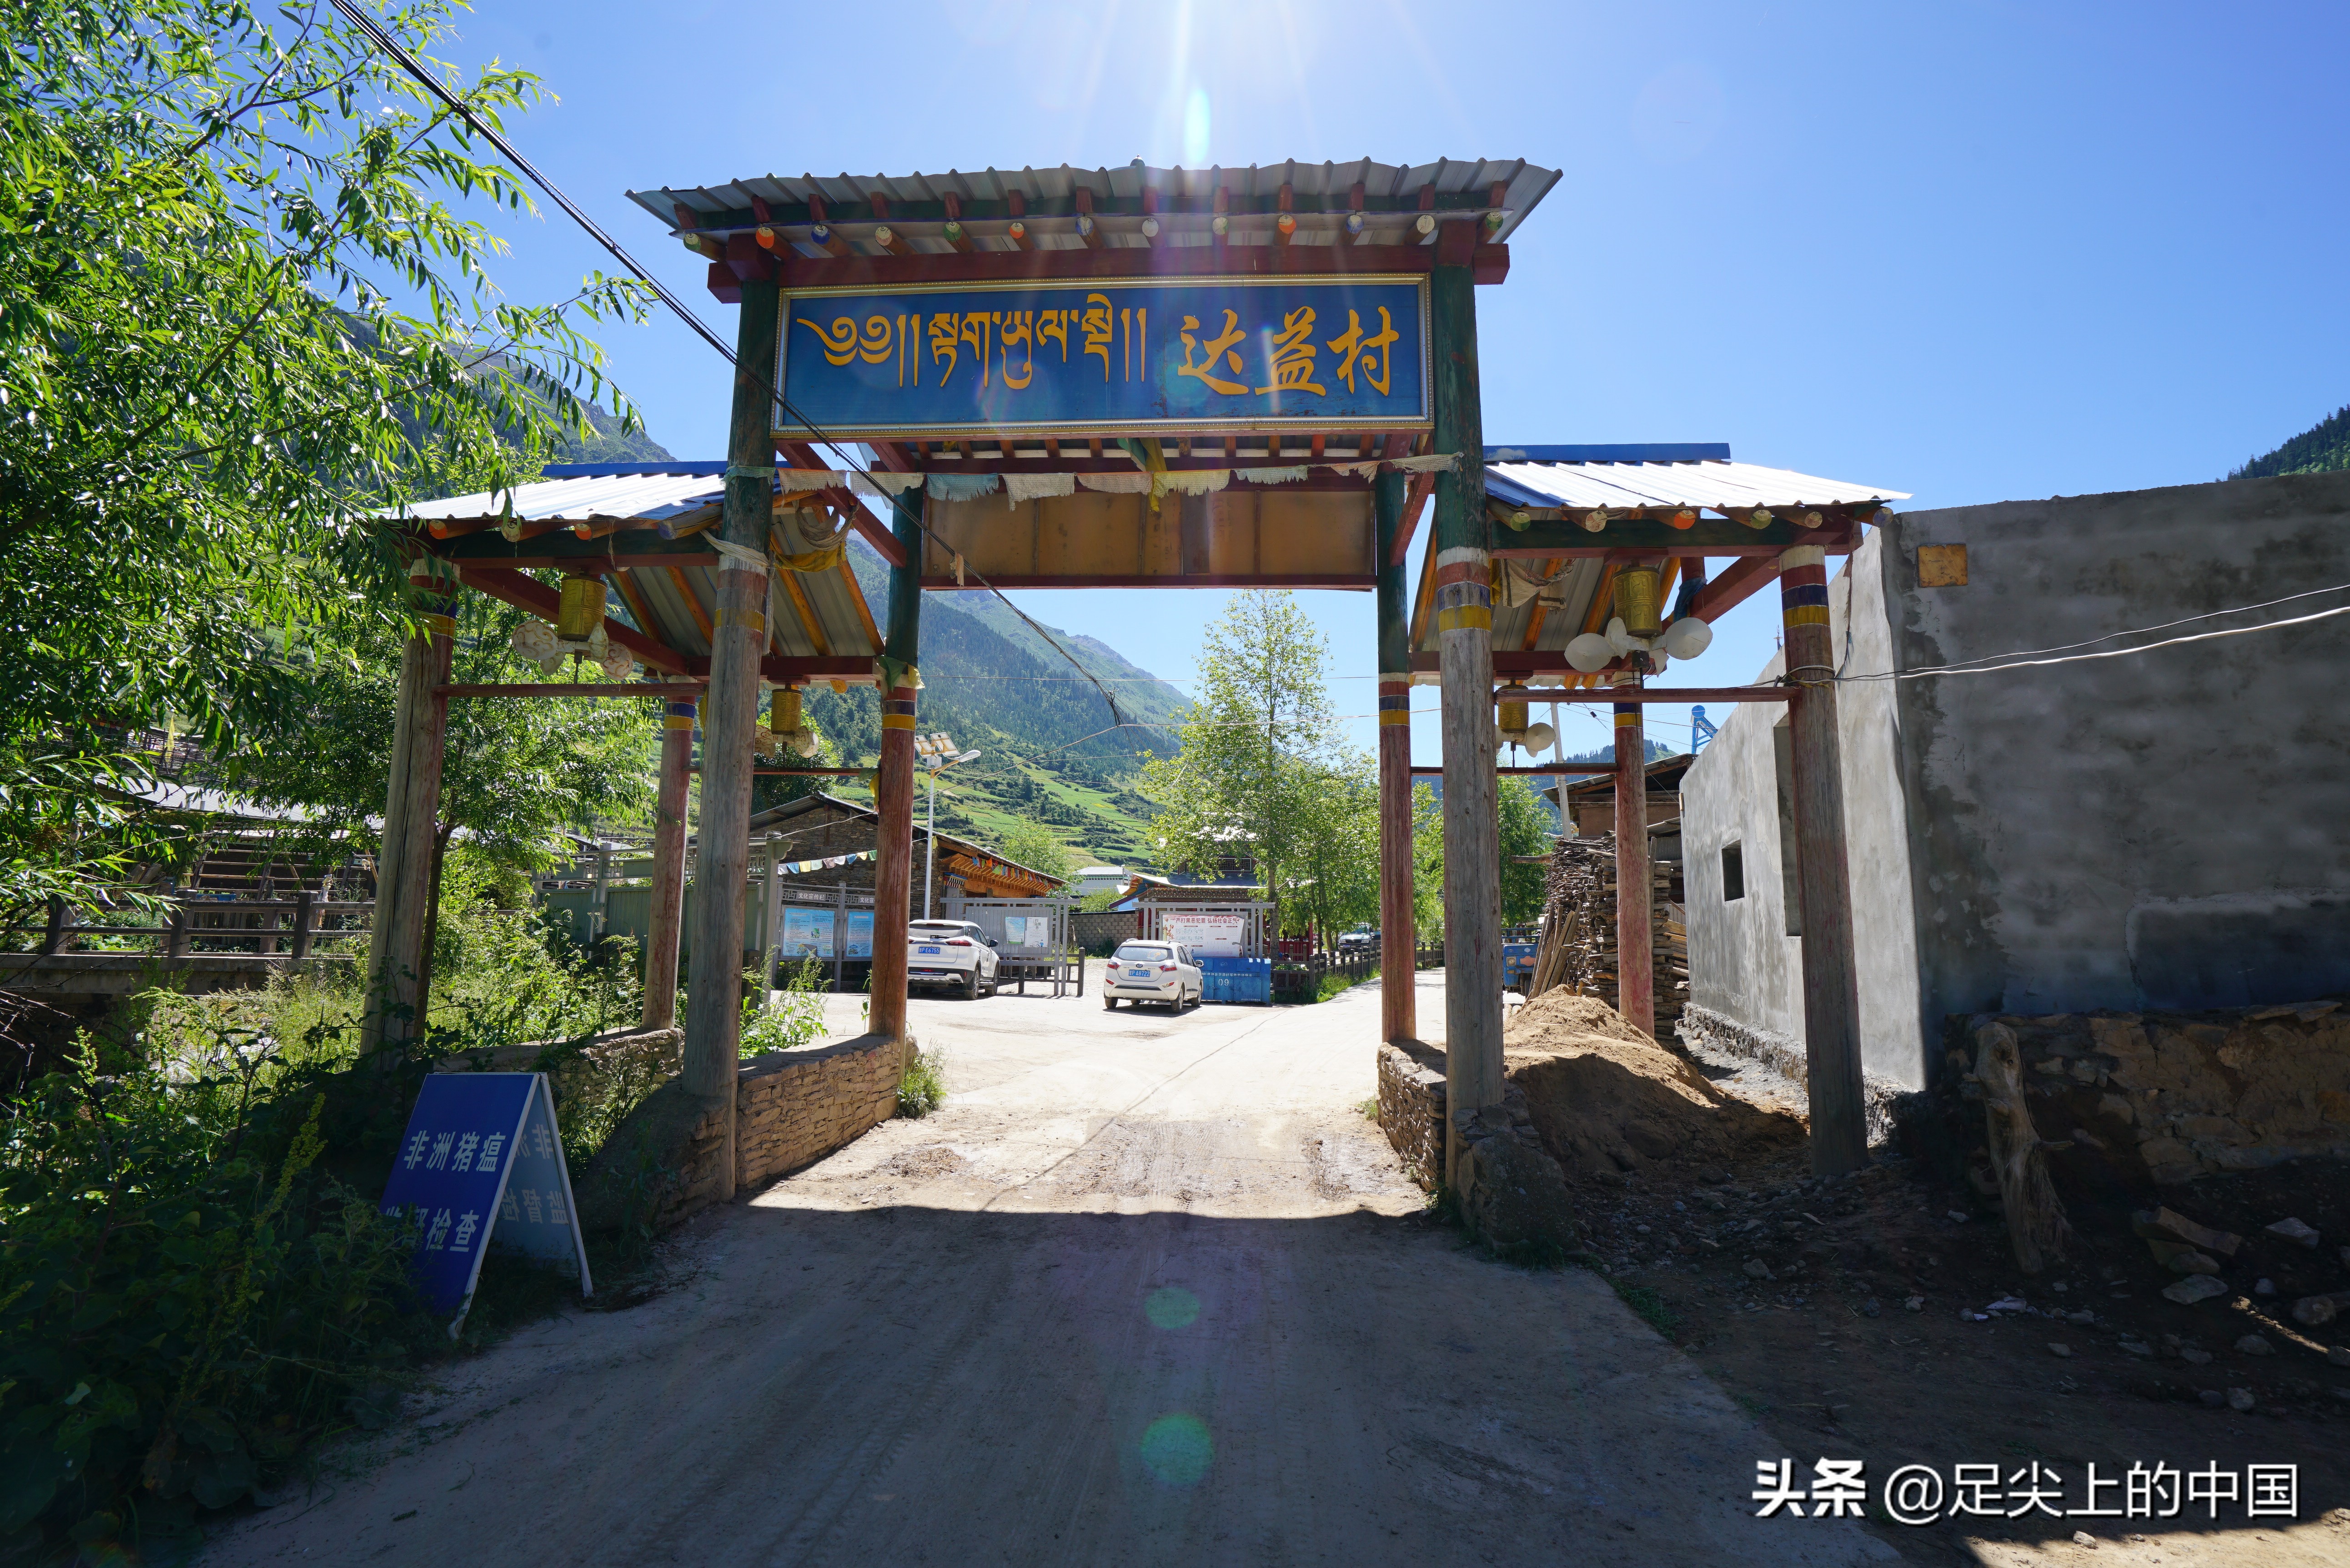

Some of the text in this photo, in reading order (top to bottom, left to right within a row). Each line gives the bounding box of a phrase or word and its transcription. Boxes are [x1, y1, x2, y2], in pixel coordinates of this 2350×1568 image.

[1178, 306, 1399, 396] 达益村
[404, 1130, 506, 1172] 非洲猪瘟
